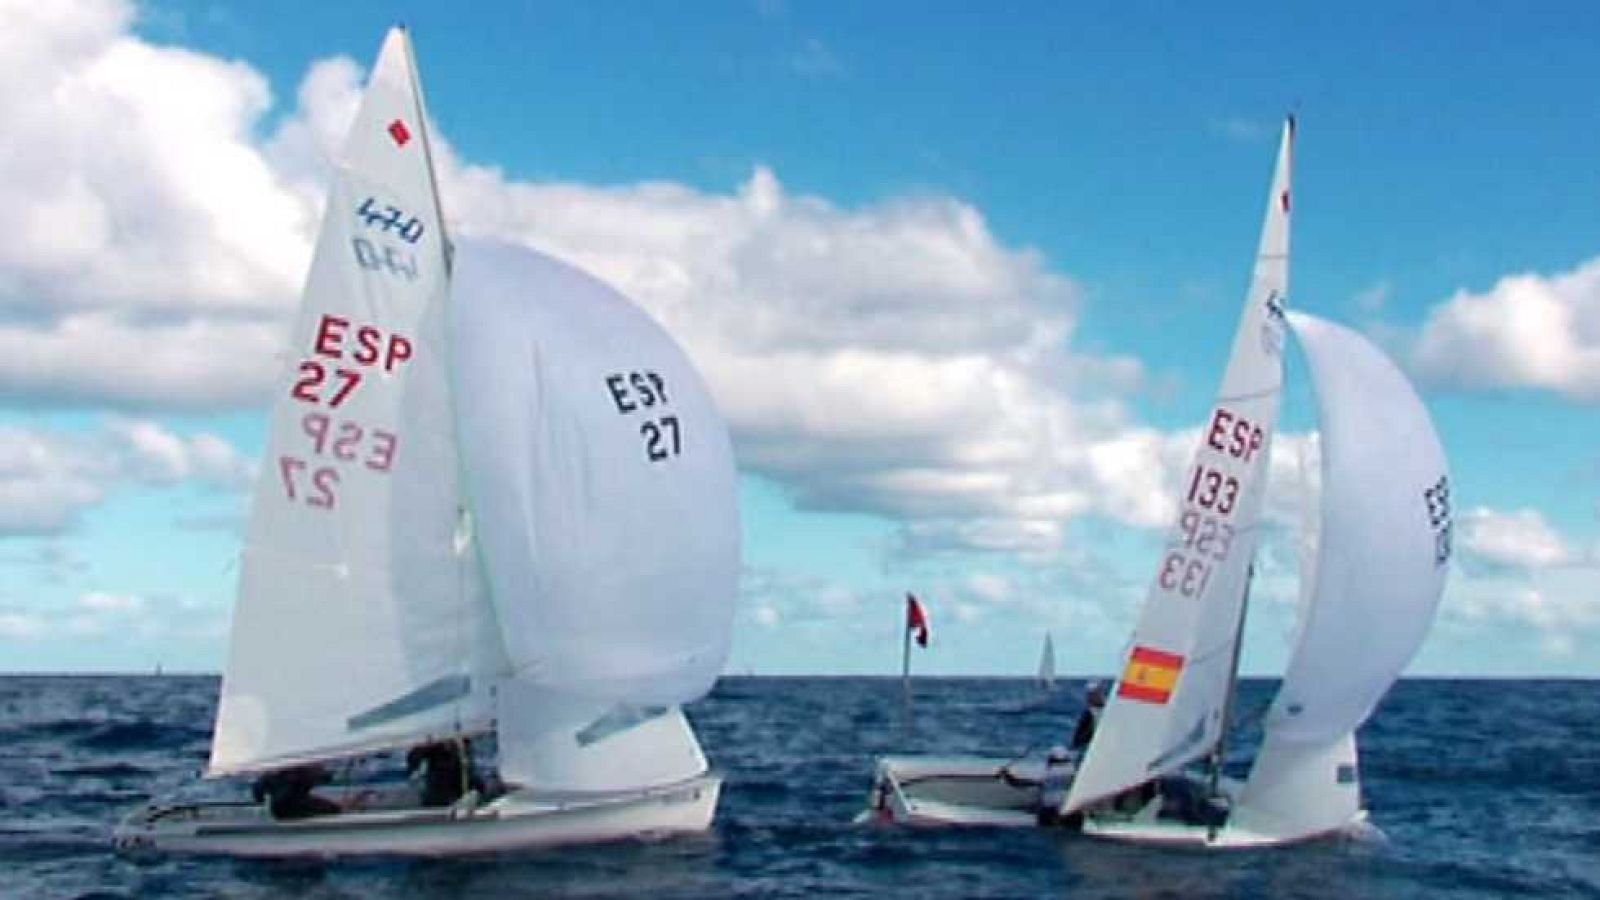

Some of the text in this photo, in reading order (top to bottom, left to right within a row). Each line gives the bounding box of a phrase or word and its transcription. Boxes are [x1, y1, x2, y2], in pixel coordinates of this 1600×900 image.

[358, 198, 424, 244] 470
[315, 314, 413, 371] ESP
[292, 362, 361, 408] 27
[640, 417, 680, 461] 27
[1208, 409, 1263, 462] ESP
[1187, 465, 1239, 514] 133
